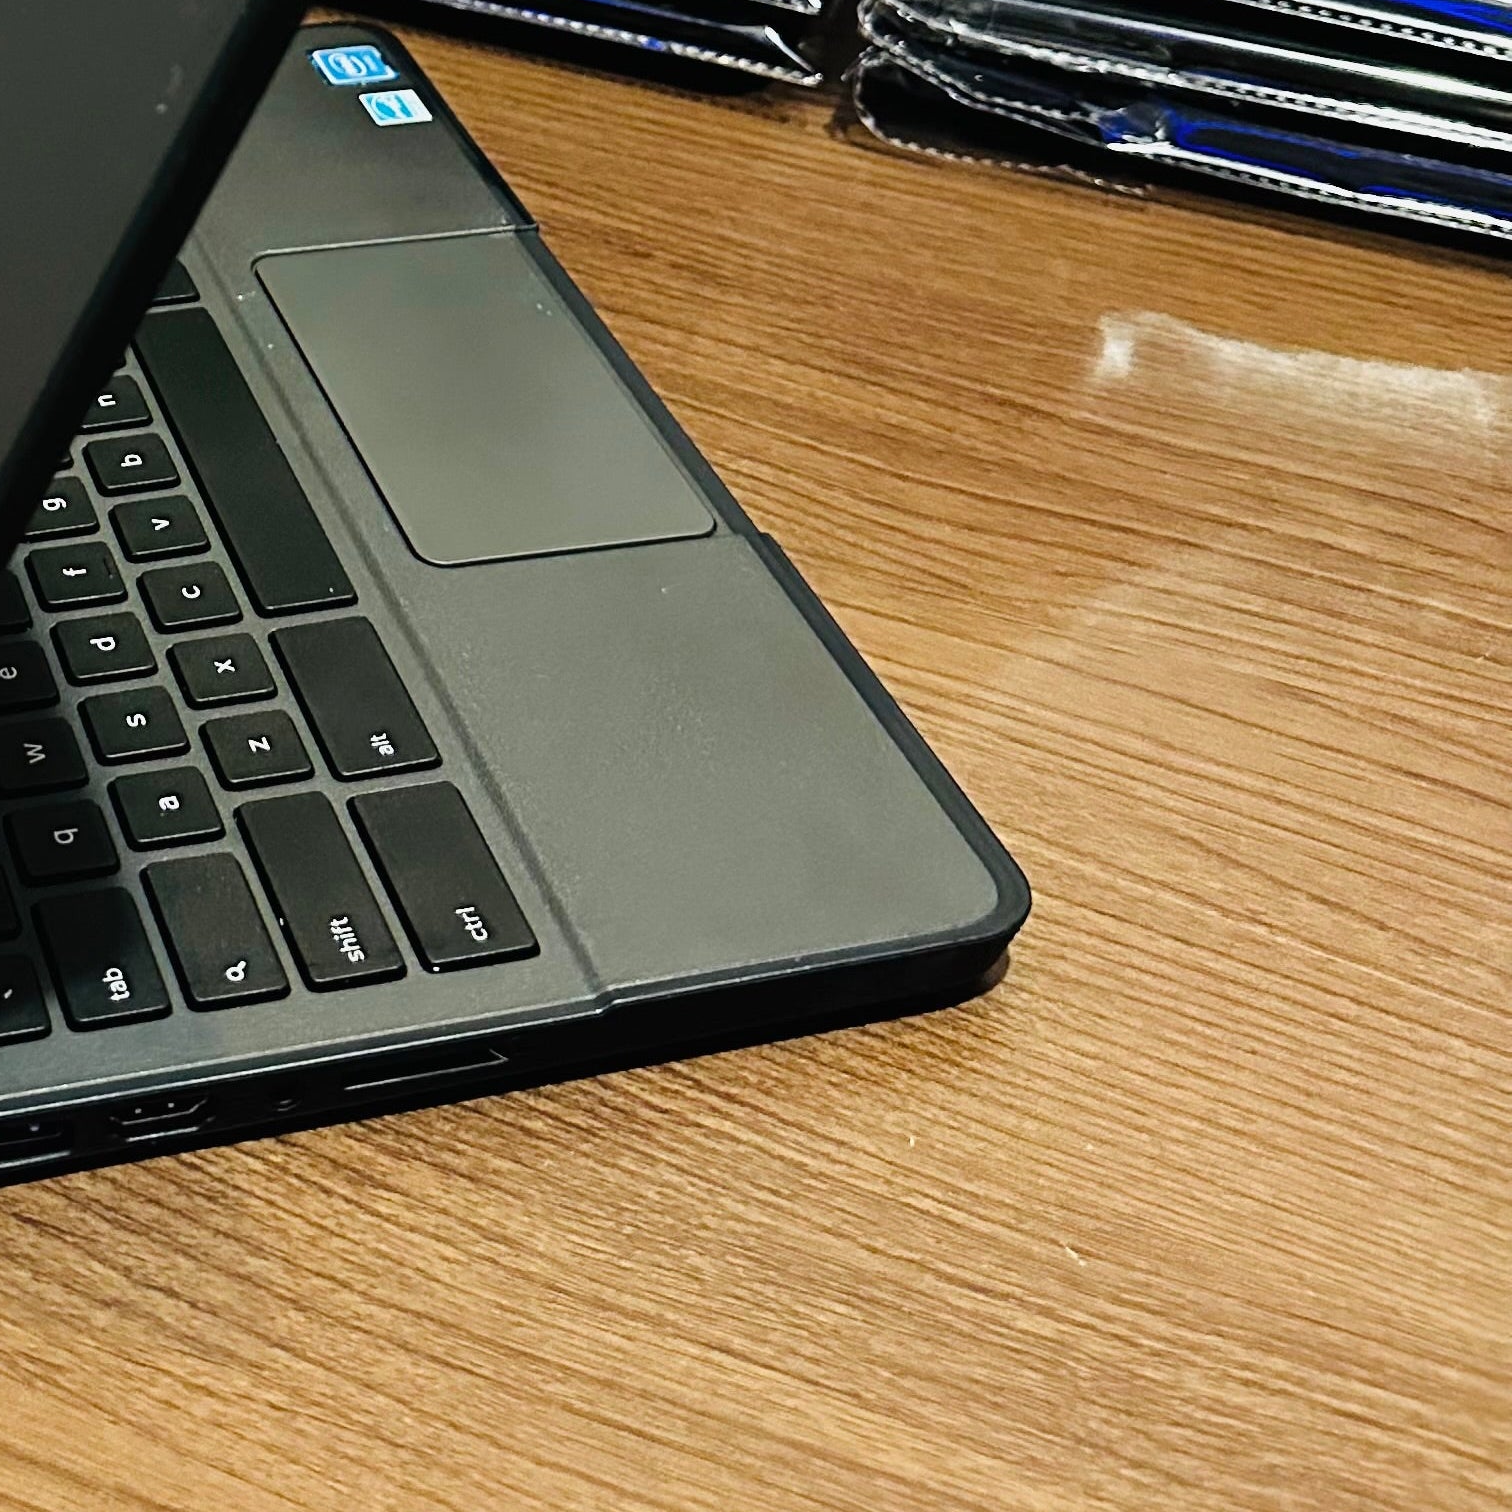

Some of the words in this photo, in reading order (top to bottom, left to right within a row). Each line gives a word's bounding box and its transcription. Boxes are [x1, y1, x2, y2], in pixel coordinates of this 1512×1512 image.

[120, 453, 143, 468] b
[42, 497, 67, 511] g
[62, 567, 87, 577] f
[89, 636, 116, 652] d
[0, 666, 18, 680] e
[370, 732, 395, 756] alt
[158, 795, 180, 811] a
[53, 828, 78, 844] q
[455, 906, 488, 942] ctrl
[330, 916, 365, 963] shift
[102, 967, 130, 1002] tab
